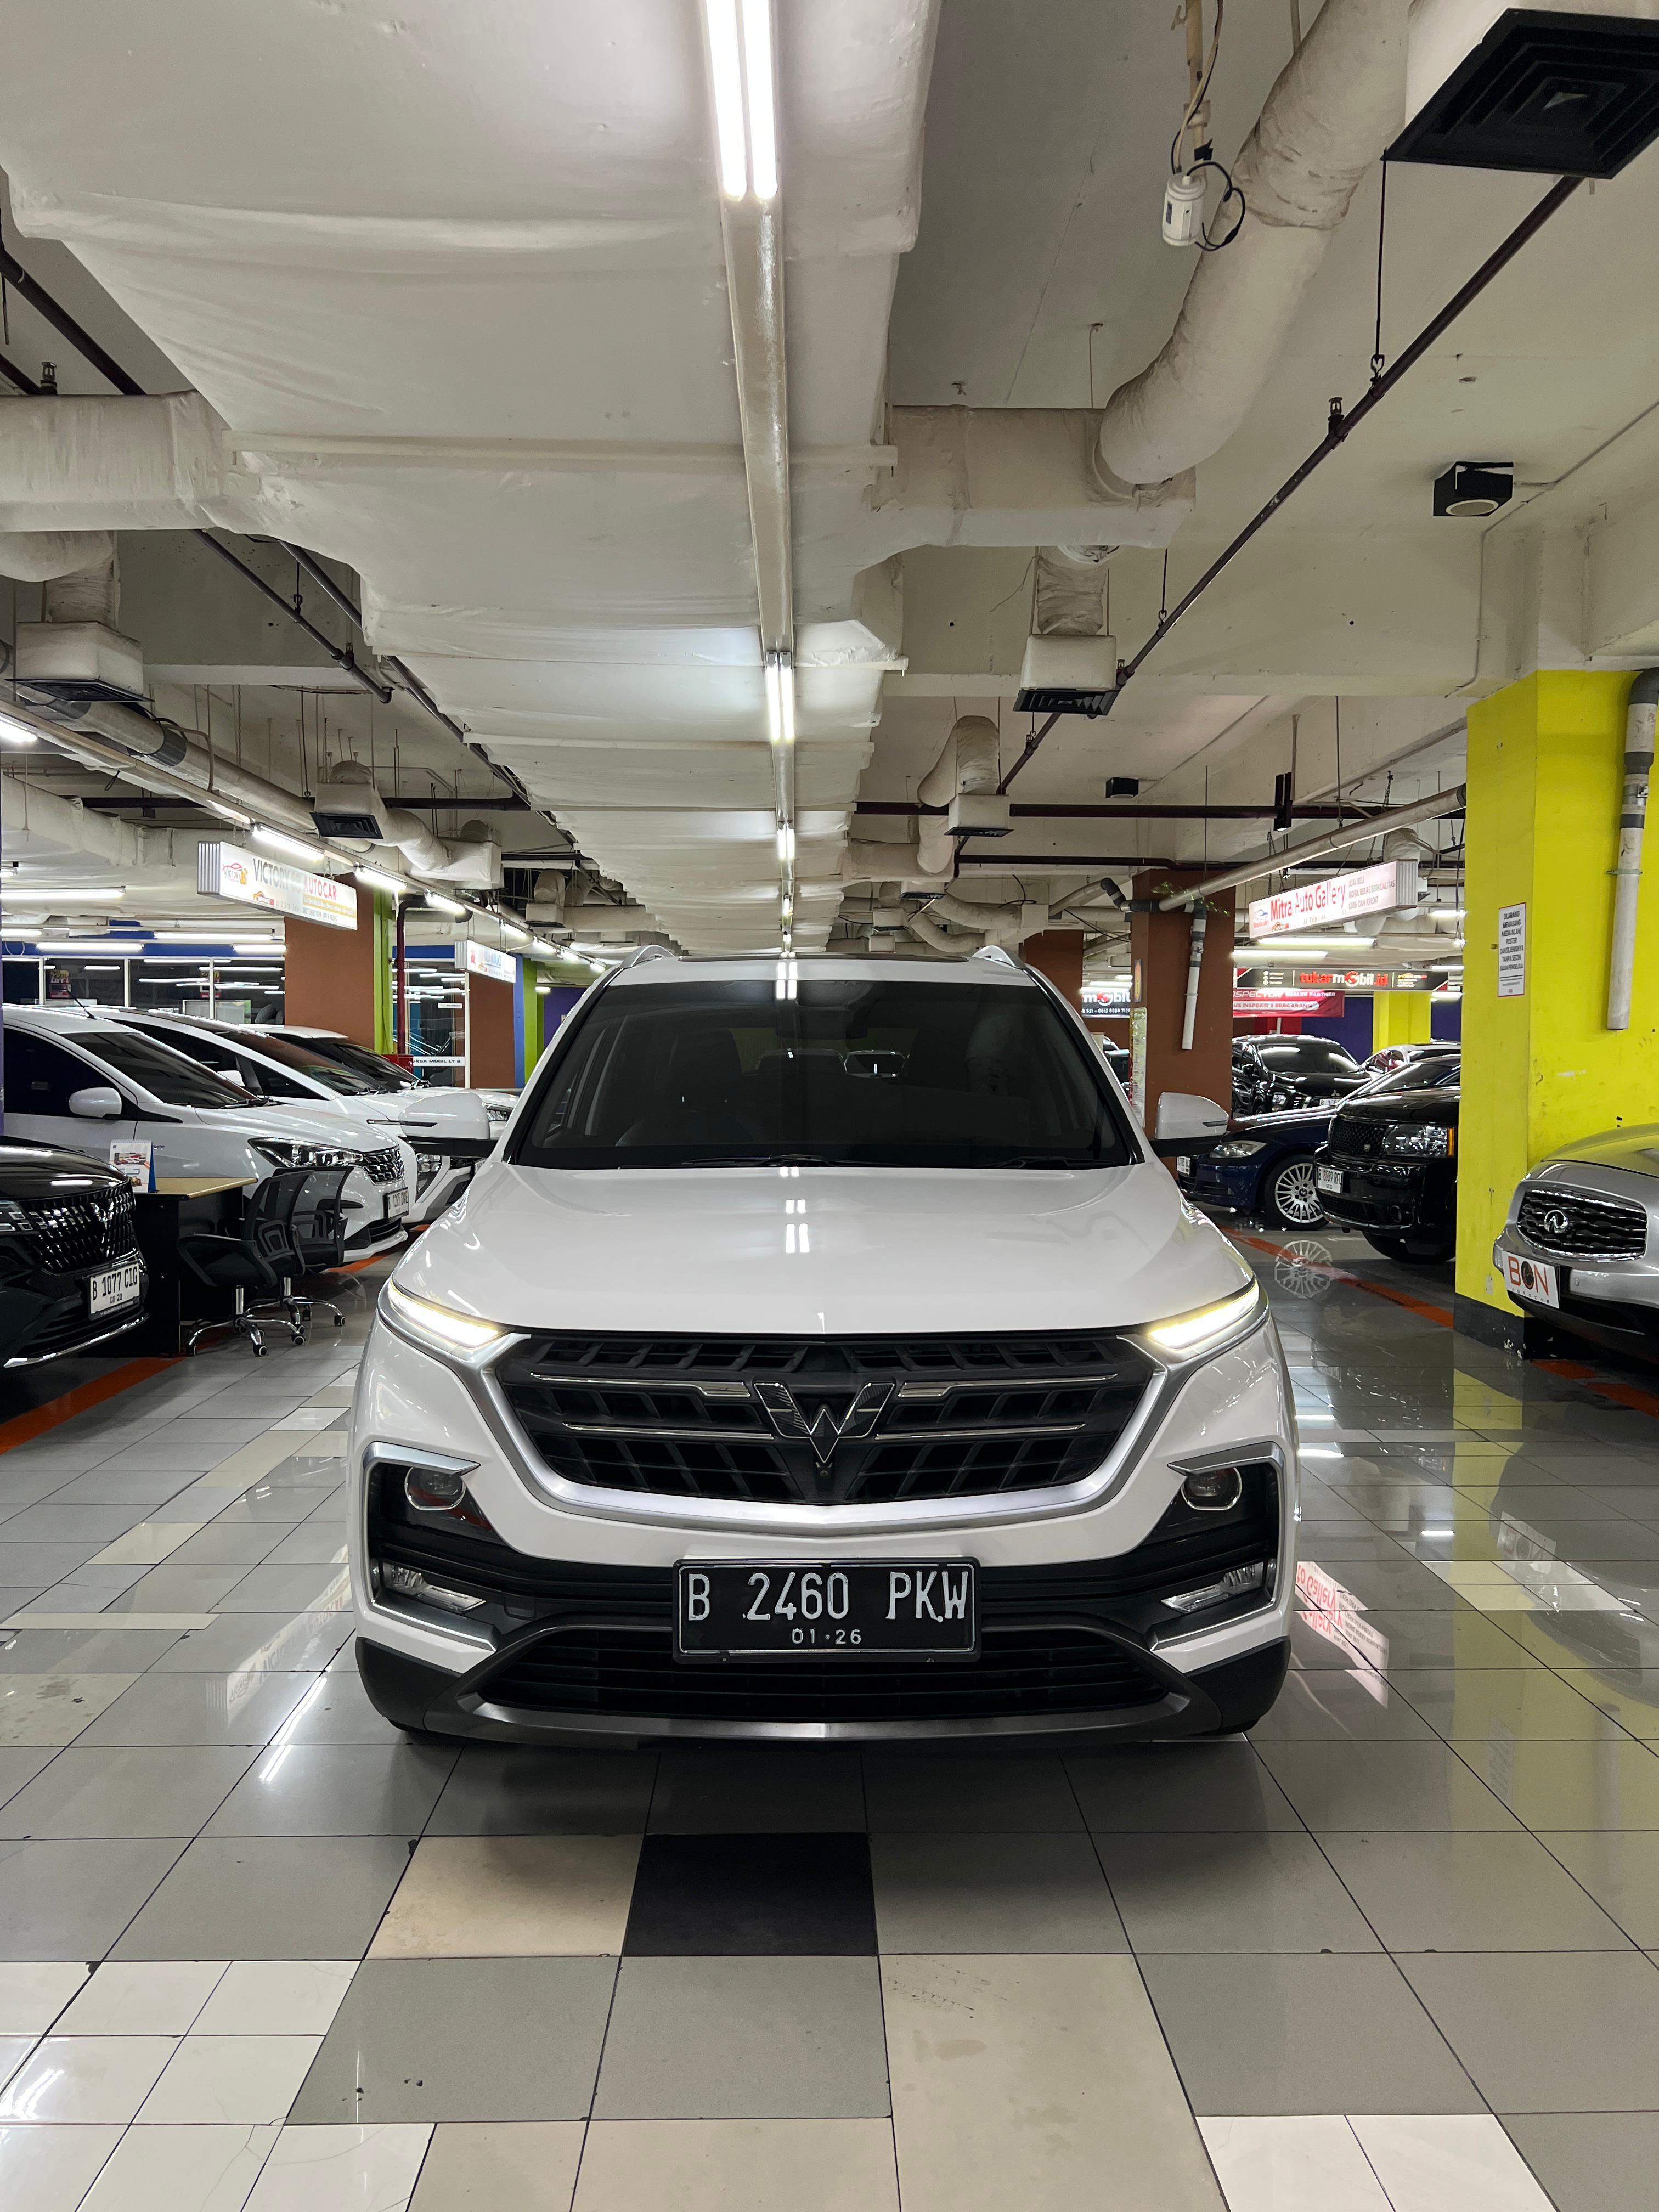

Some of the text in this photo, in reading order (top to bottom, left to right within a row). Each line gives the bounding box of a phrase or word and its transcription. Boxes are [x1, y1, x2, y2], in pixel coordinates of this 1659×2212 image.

[253, 858, 290, 889] VICTORY
[304, 877, 337, 900] AUTOCAR
[1271, 900, 1292, 921] Mitra
[1295, 892, 1313, 915] Auto
[1316, 882, 1346, 909] Gallery
[93, 1266, 137, 1300] B 1077 CIG
[688, 1571, 968, 1621] B 2460 PKW
